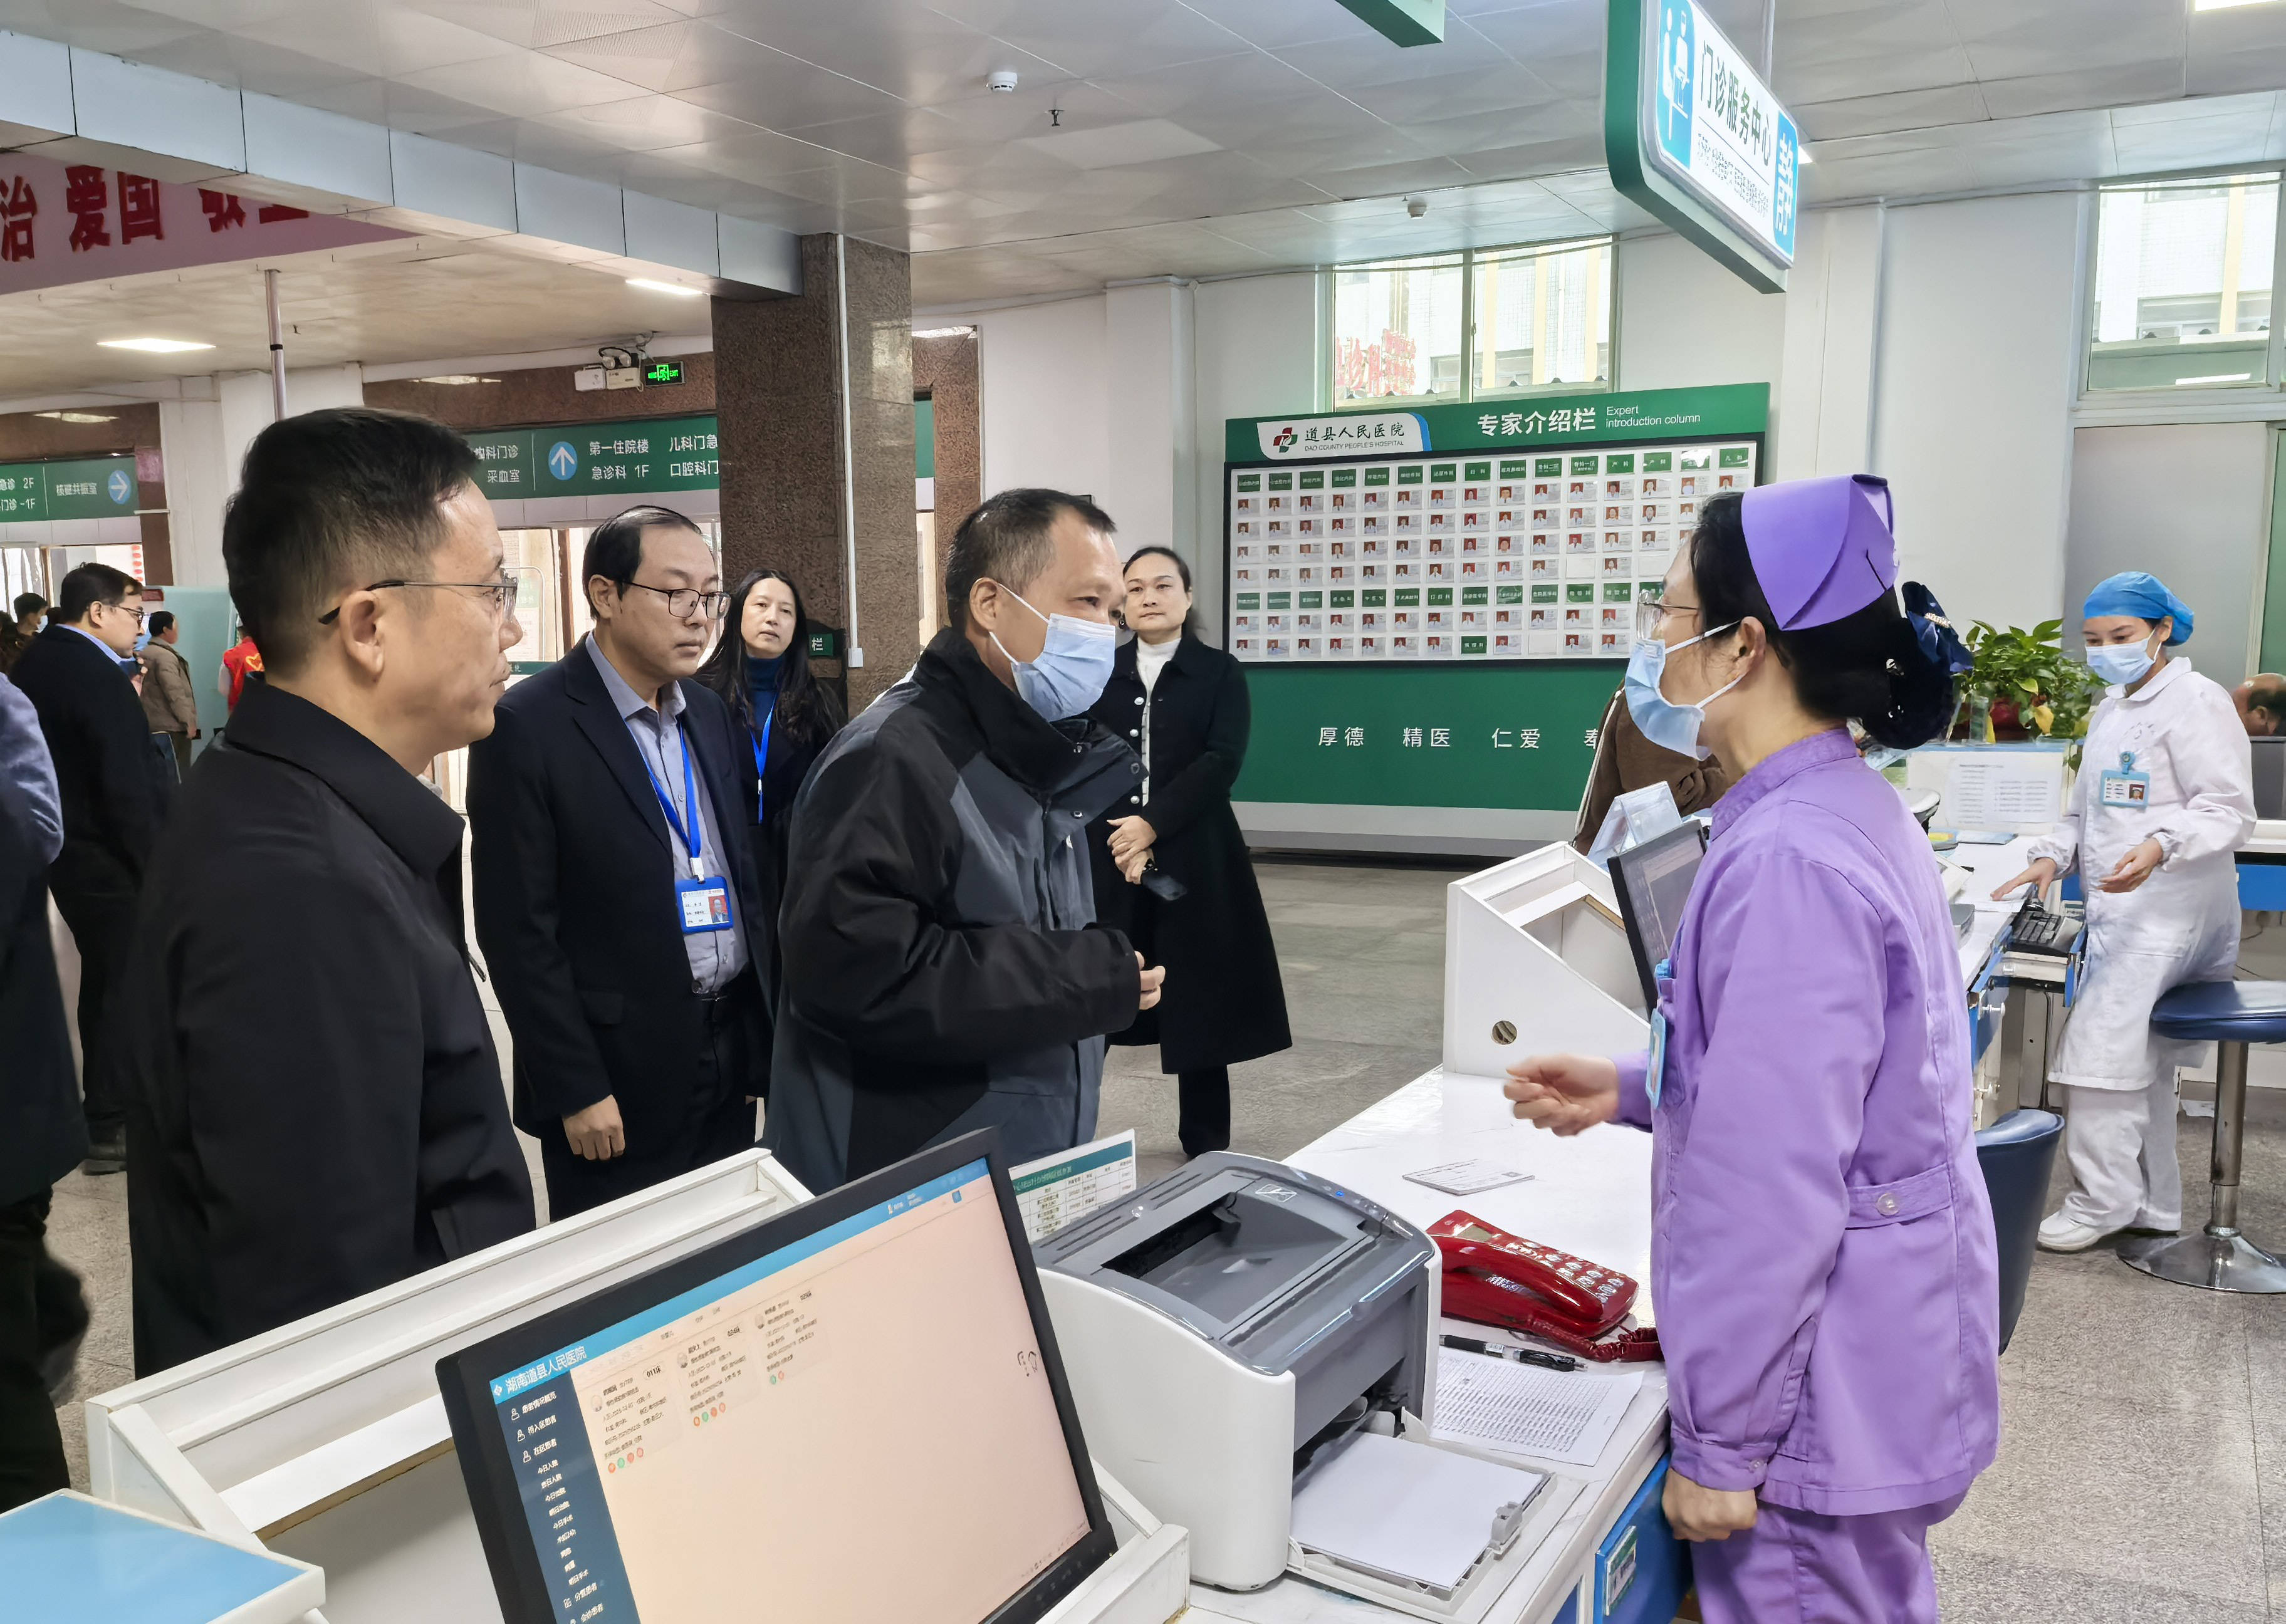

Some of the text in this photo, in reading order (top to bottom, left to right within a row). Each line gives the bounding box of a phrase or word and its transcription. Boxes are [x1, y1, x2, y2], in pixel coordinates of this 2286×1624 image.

[1701, 40, 1771, 166] 门诊服务中心
[1775, 133, 1794, 236] 静
[0, 175, 37, 262] 治
[65, 165, 164, 252] 爱国
[1607, 405, 1639, 416] Expert
[1478, 407, 1596, 437] 专家介绍栏
[1605, 414, 1701, 428] introduction column
[1305, 422, 1404, 442] 道县人民医院
[589, 439, 649, 455] 第一住院楼
[669, 434, 718, 452] 儿科门急
[488, 469, 520, 483] 采血室
[592, 464, 650, 480] 急诊科 1F
[670, 460, 719, 477] 口腔科门
[23, 477, 34, 488] 2F
[0, 499, 18, 511] 门诊
[812, 637, 823, 651] 栏
[1318, 726, 1364, 747] 厚德
[1402, 727, 1451, 748] 精医
[1491, 727, 1541, 749] 仁爱
[505, 1346, 587, 1393] 湖南道县人民医院
